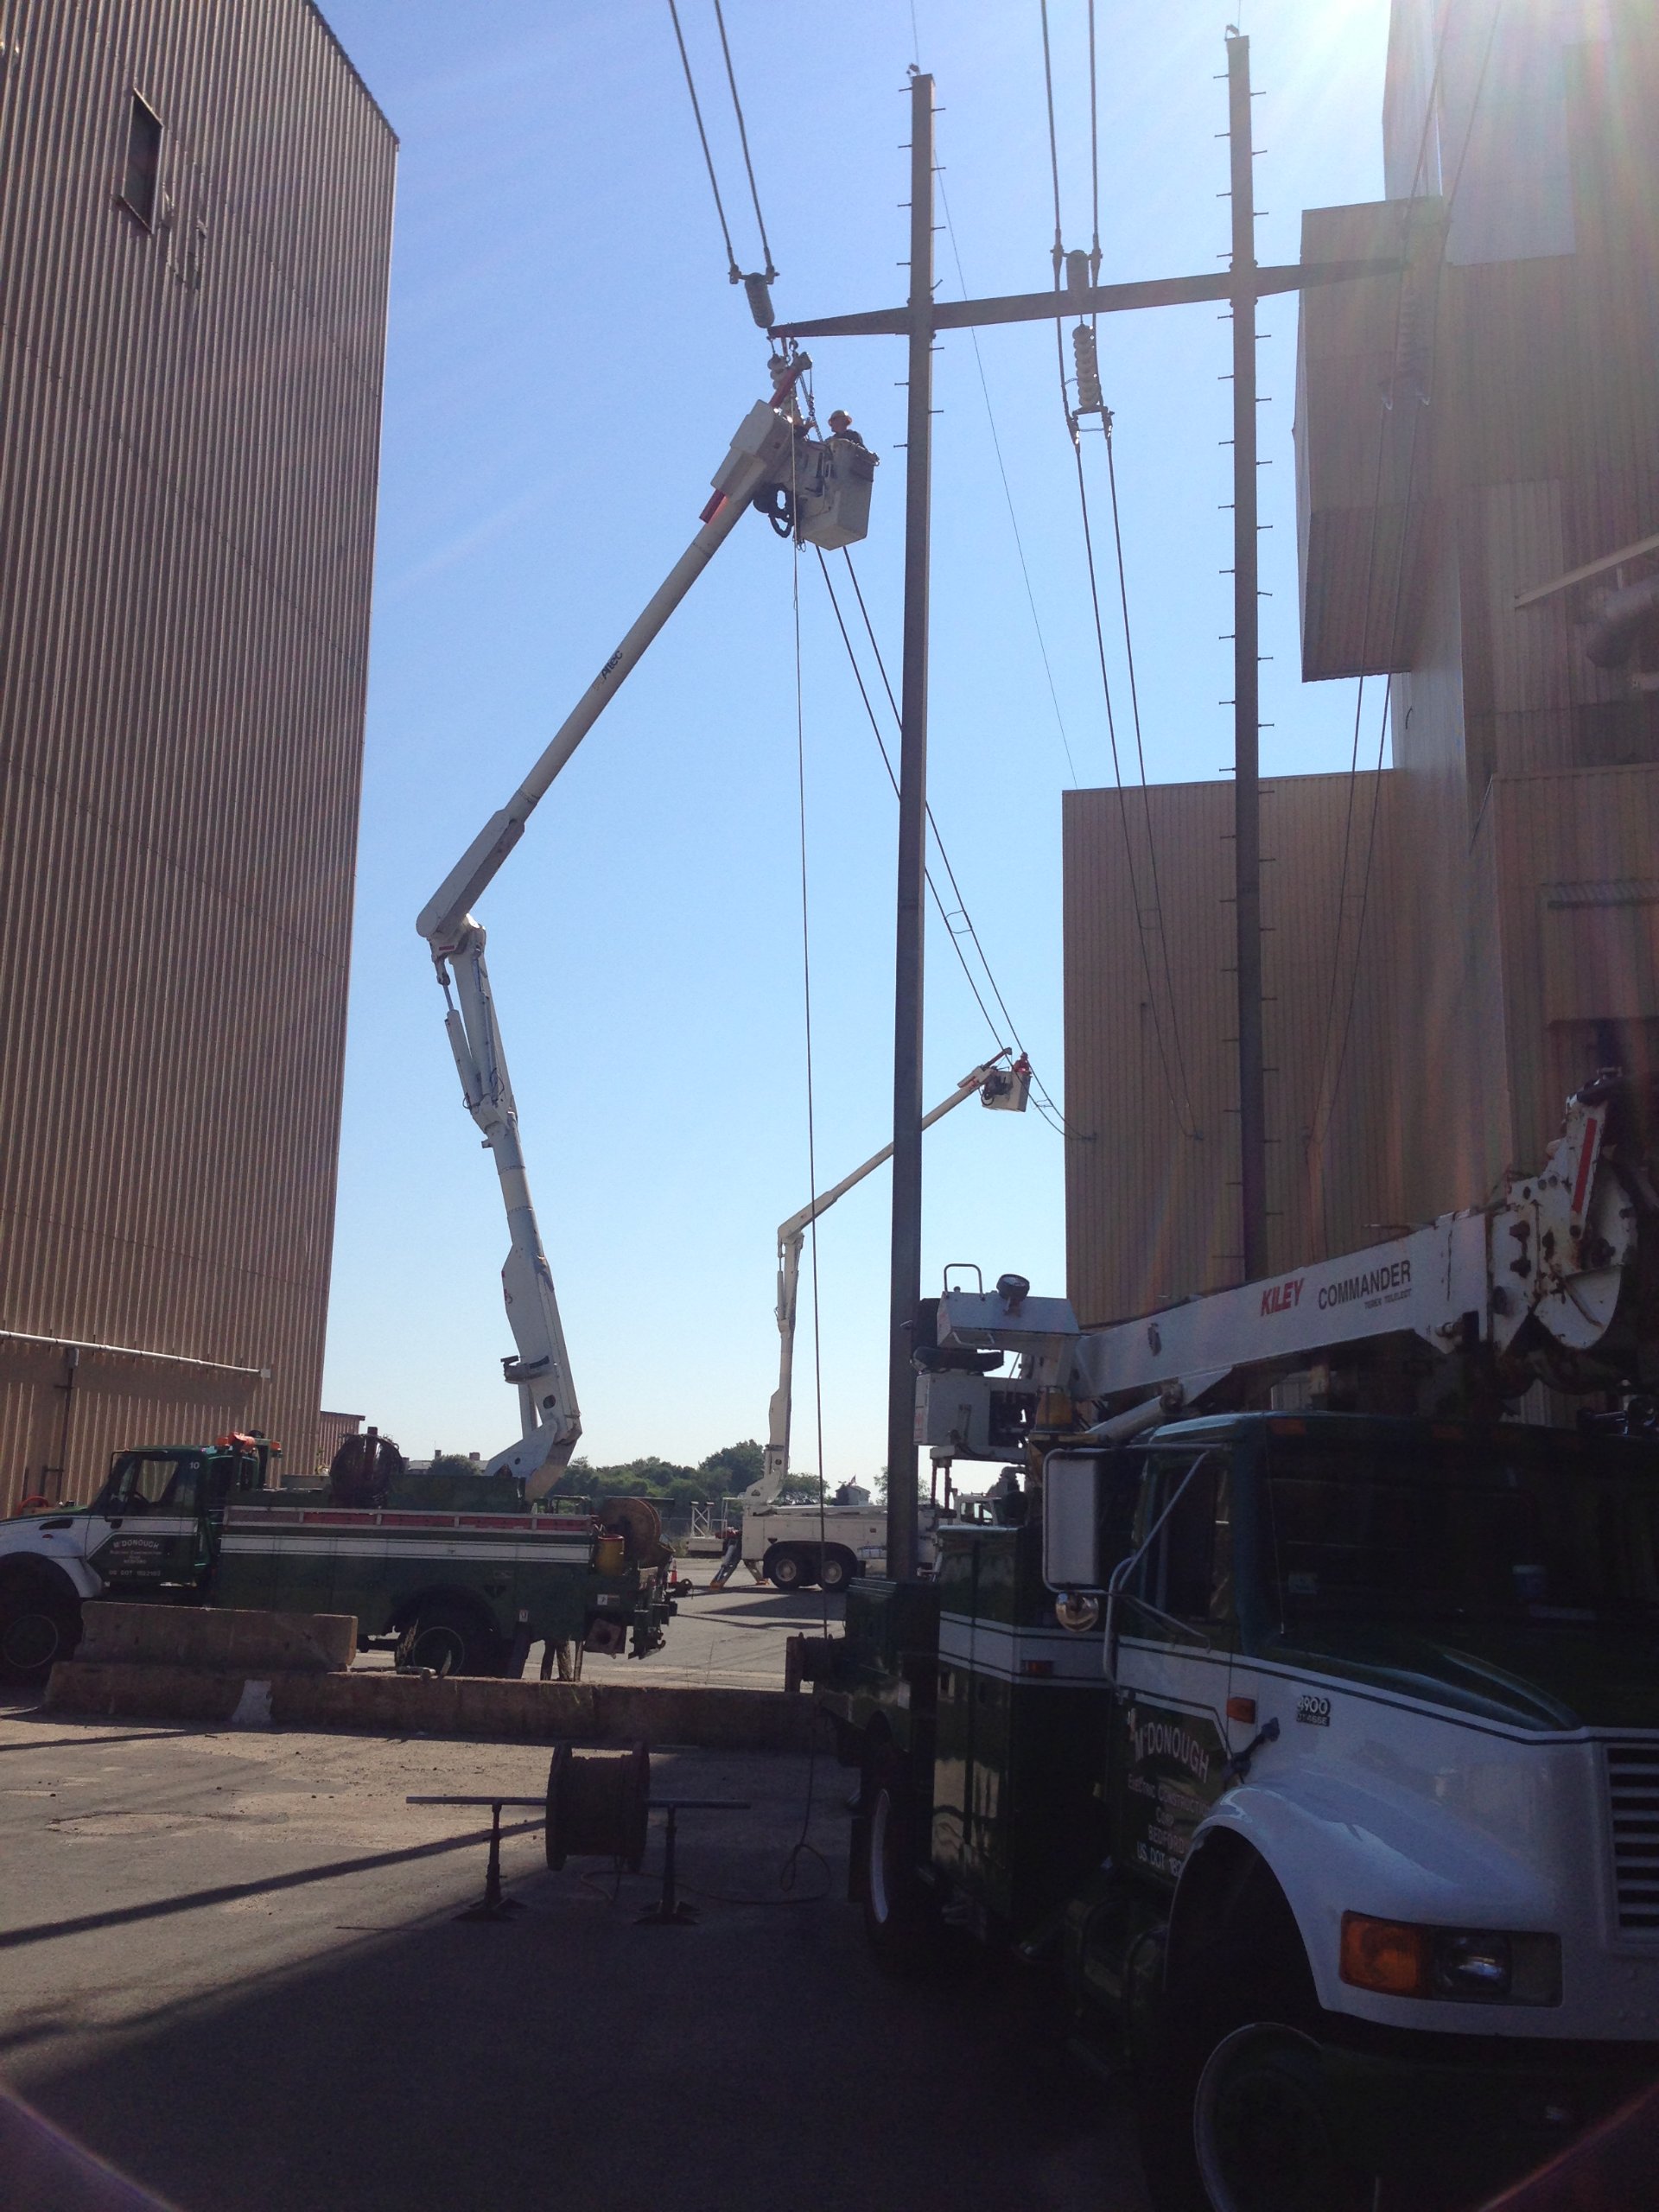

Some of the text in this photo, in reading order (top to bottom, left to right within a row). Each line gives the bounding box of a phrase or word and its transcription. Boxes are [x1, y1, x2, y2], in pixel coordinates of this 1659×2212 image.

[601, 650, 623, 680] Altec
[1261, 1259, 1412, 1317] KILEY COMMANDER
[188, 1460, 200, 1470] 10
[1297, 1694, 1330, 1716] 4900
[1147, 1823, 1185, 1854] BEDFORD
[1136, 1840, 1148, 1862] US
[1149, 1846, 1166, 1871] DOT
